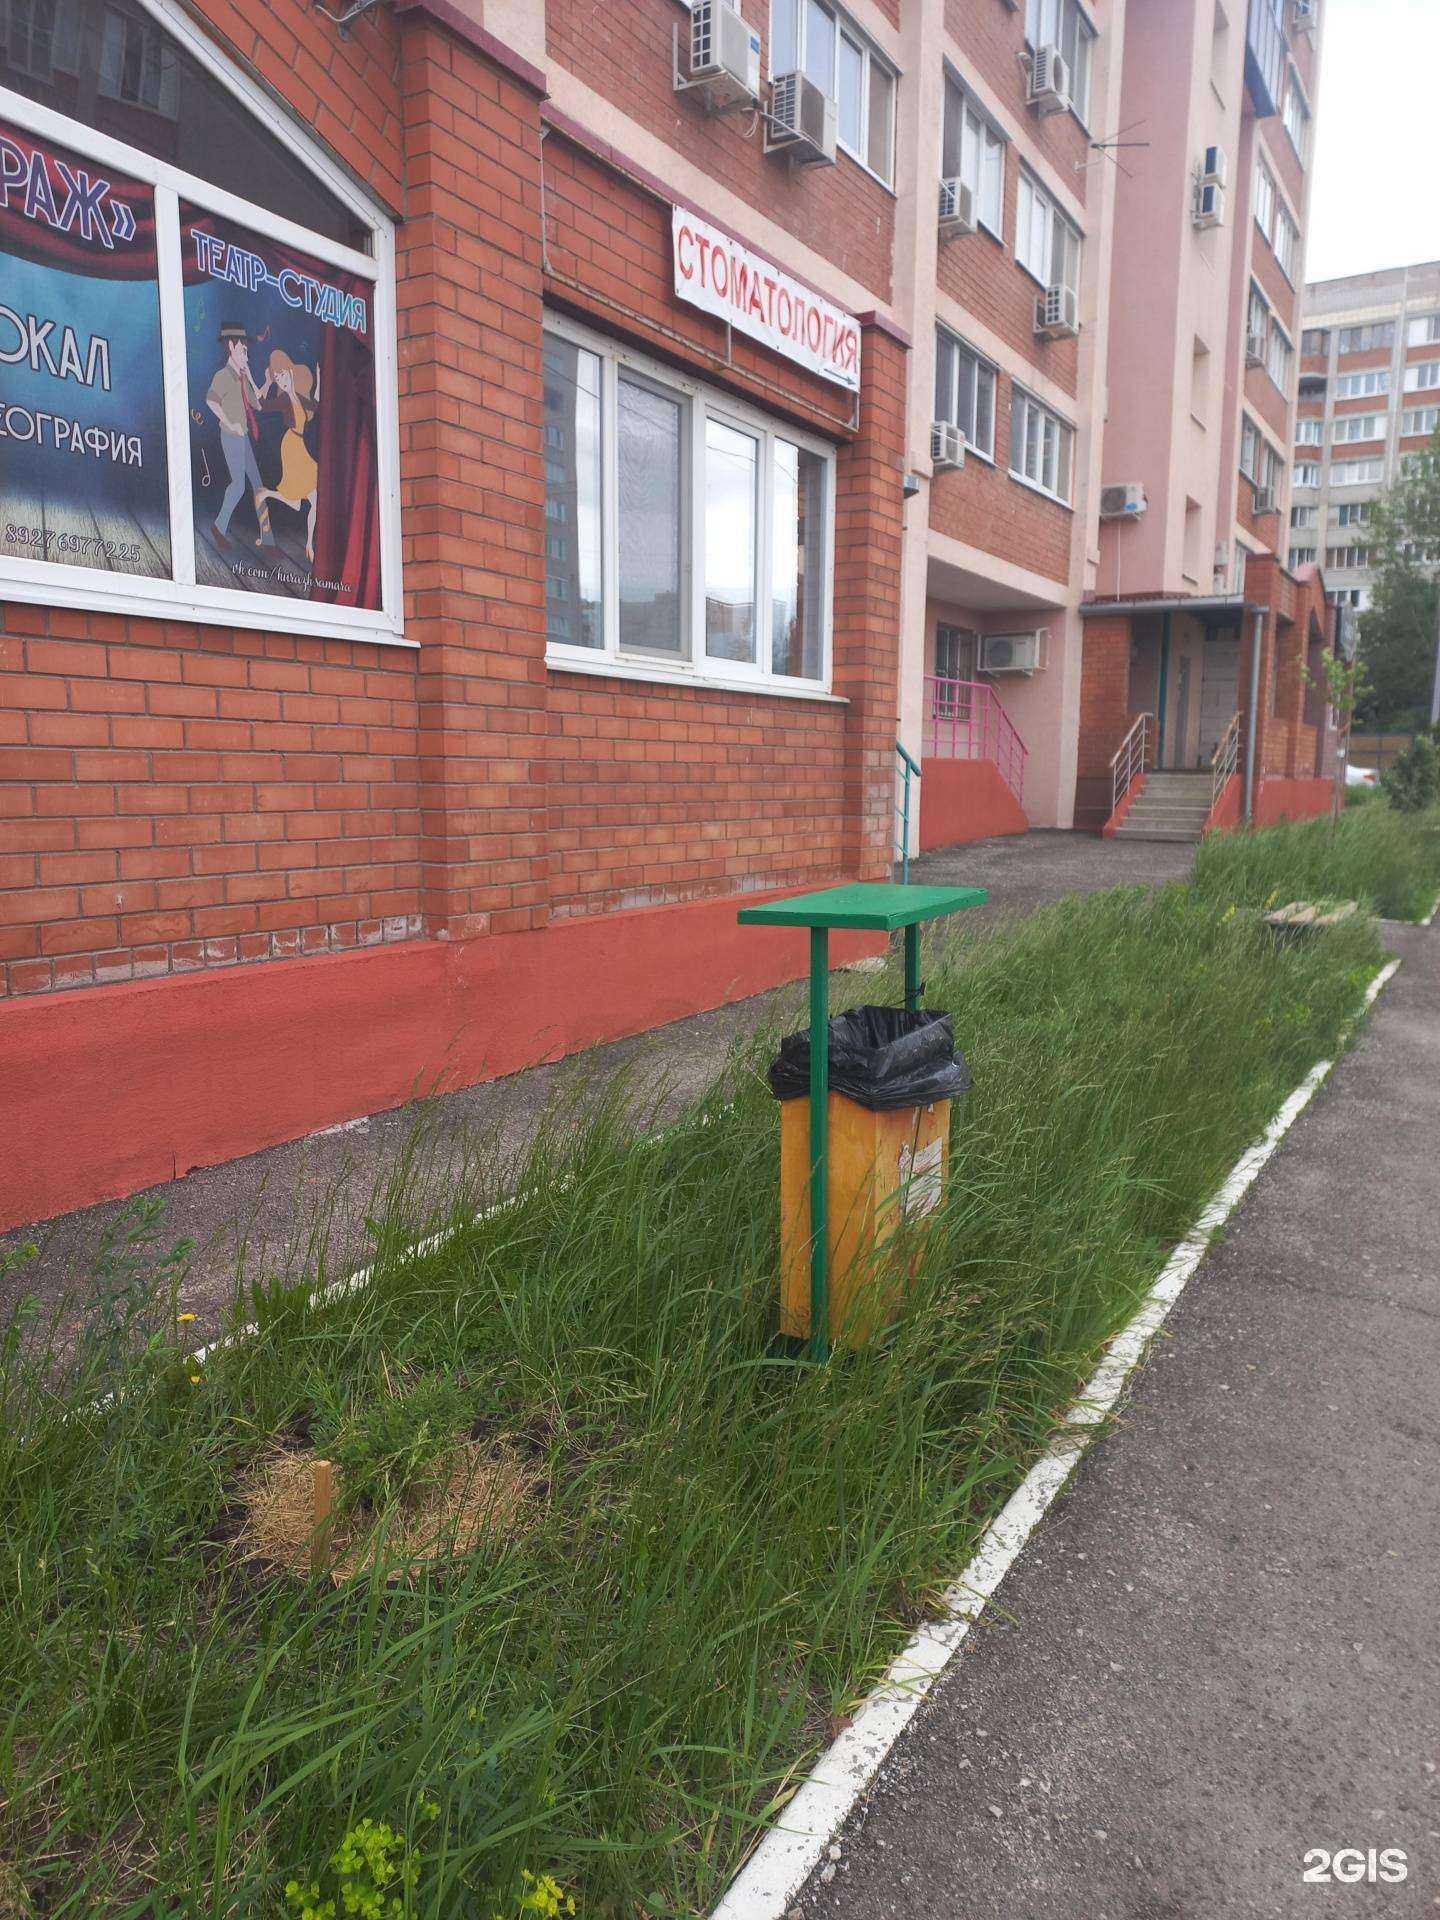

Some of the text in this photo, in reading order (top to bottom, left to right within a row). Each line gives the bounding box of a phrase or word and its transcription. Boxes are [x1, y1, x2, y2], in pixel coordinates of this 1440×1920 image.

[0, 135, 136, 249] РАЖ»
[191, 229, 367, 334] ТЕАТР-СТУДИЯ
[678, 226, 859, 374] СТОМАТОЛОГИЯ
